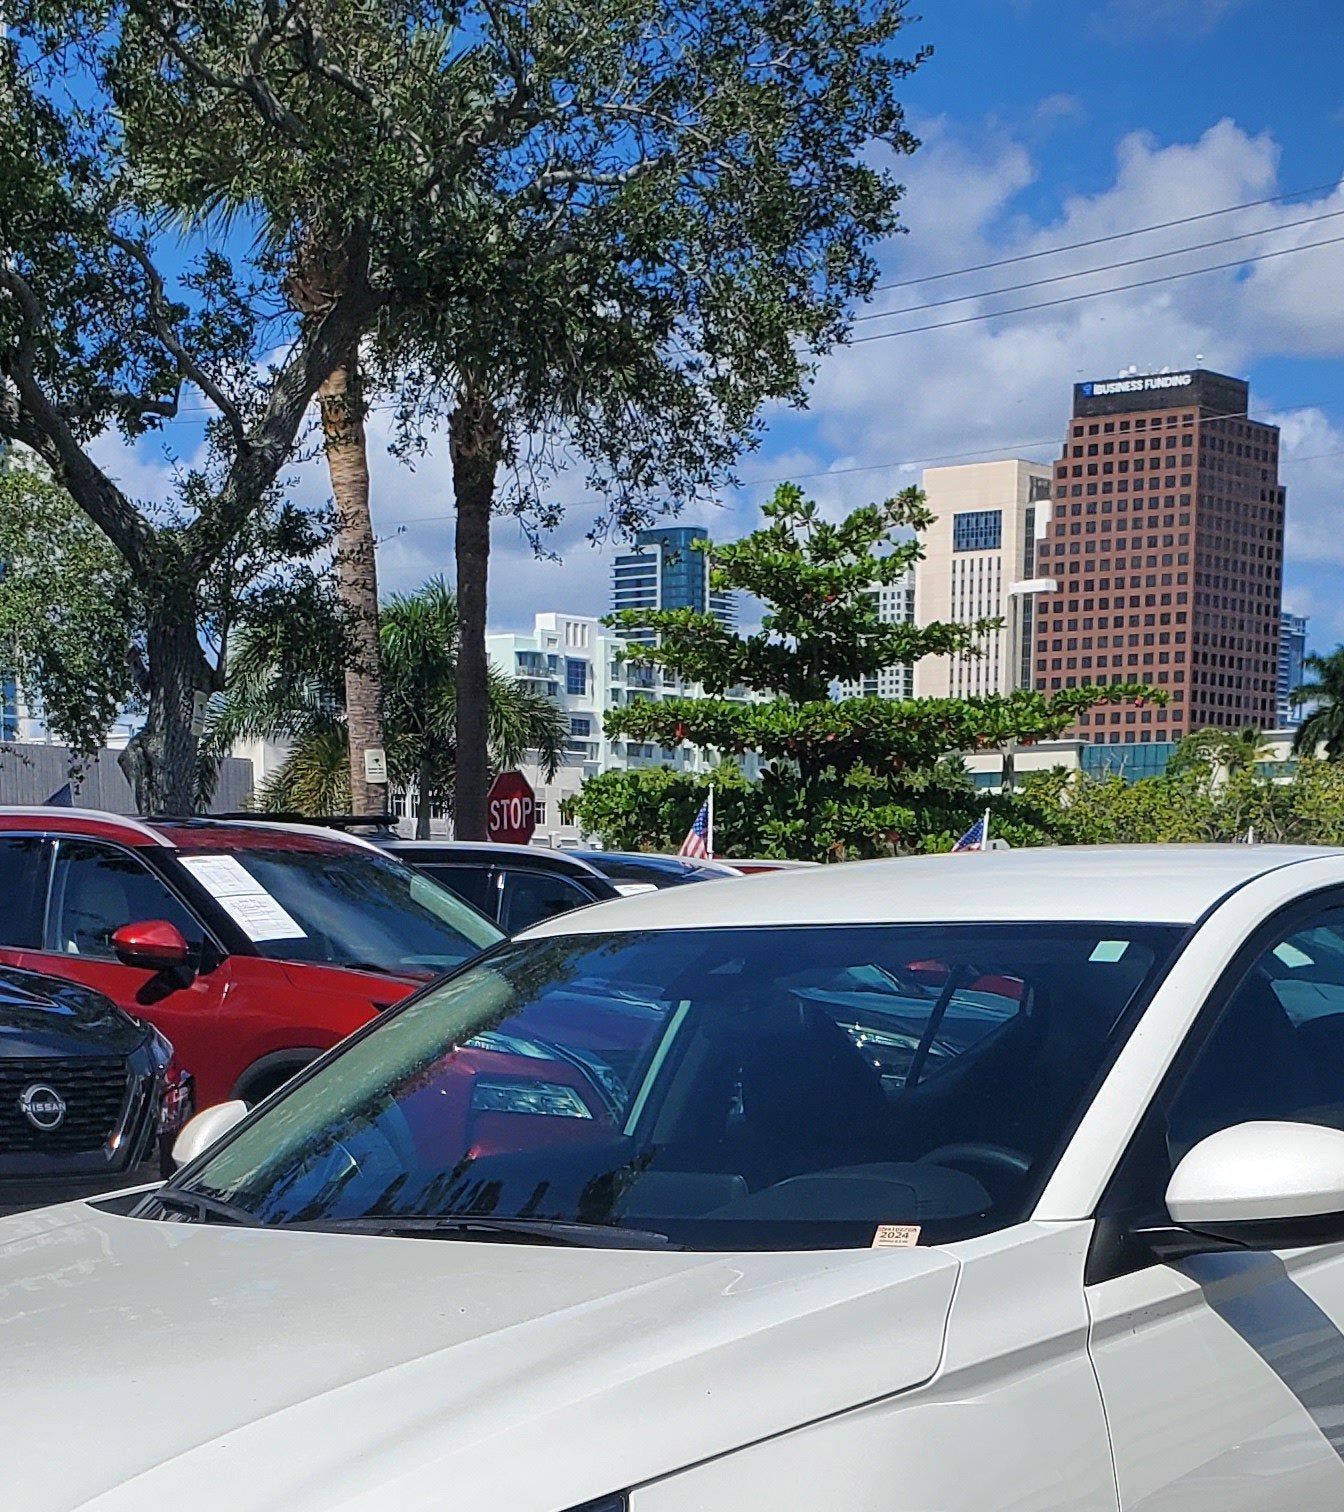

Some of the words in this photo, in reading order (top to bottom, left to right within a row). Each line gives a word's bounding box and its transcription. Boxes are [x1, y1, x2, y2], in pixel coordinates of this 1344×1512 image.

[1145, 375, 1191, 390] FUNDING
[490, 798, 532, 831] STOP
[22, 1102, 66, 1113] NISSAN
[879, 1231, 909, 1239] 2024
